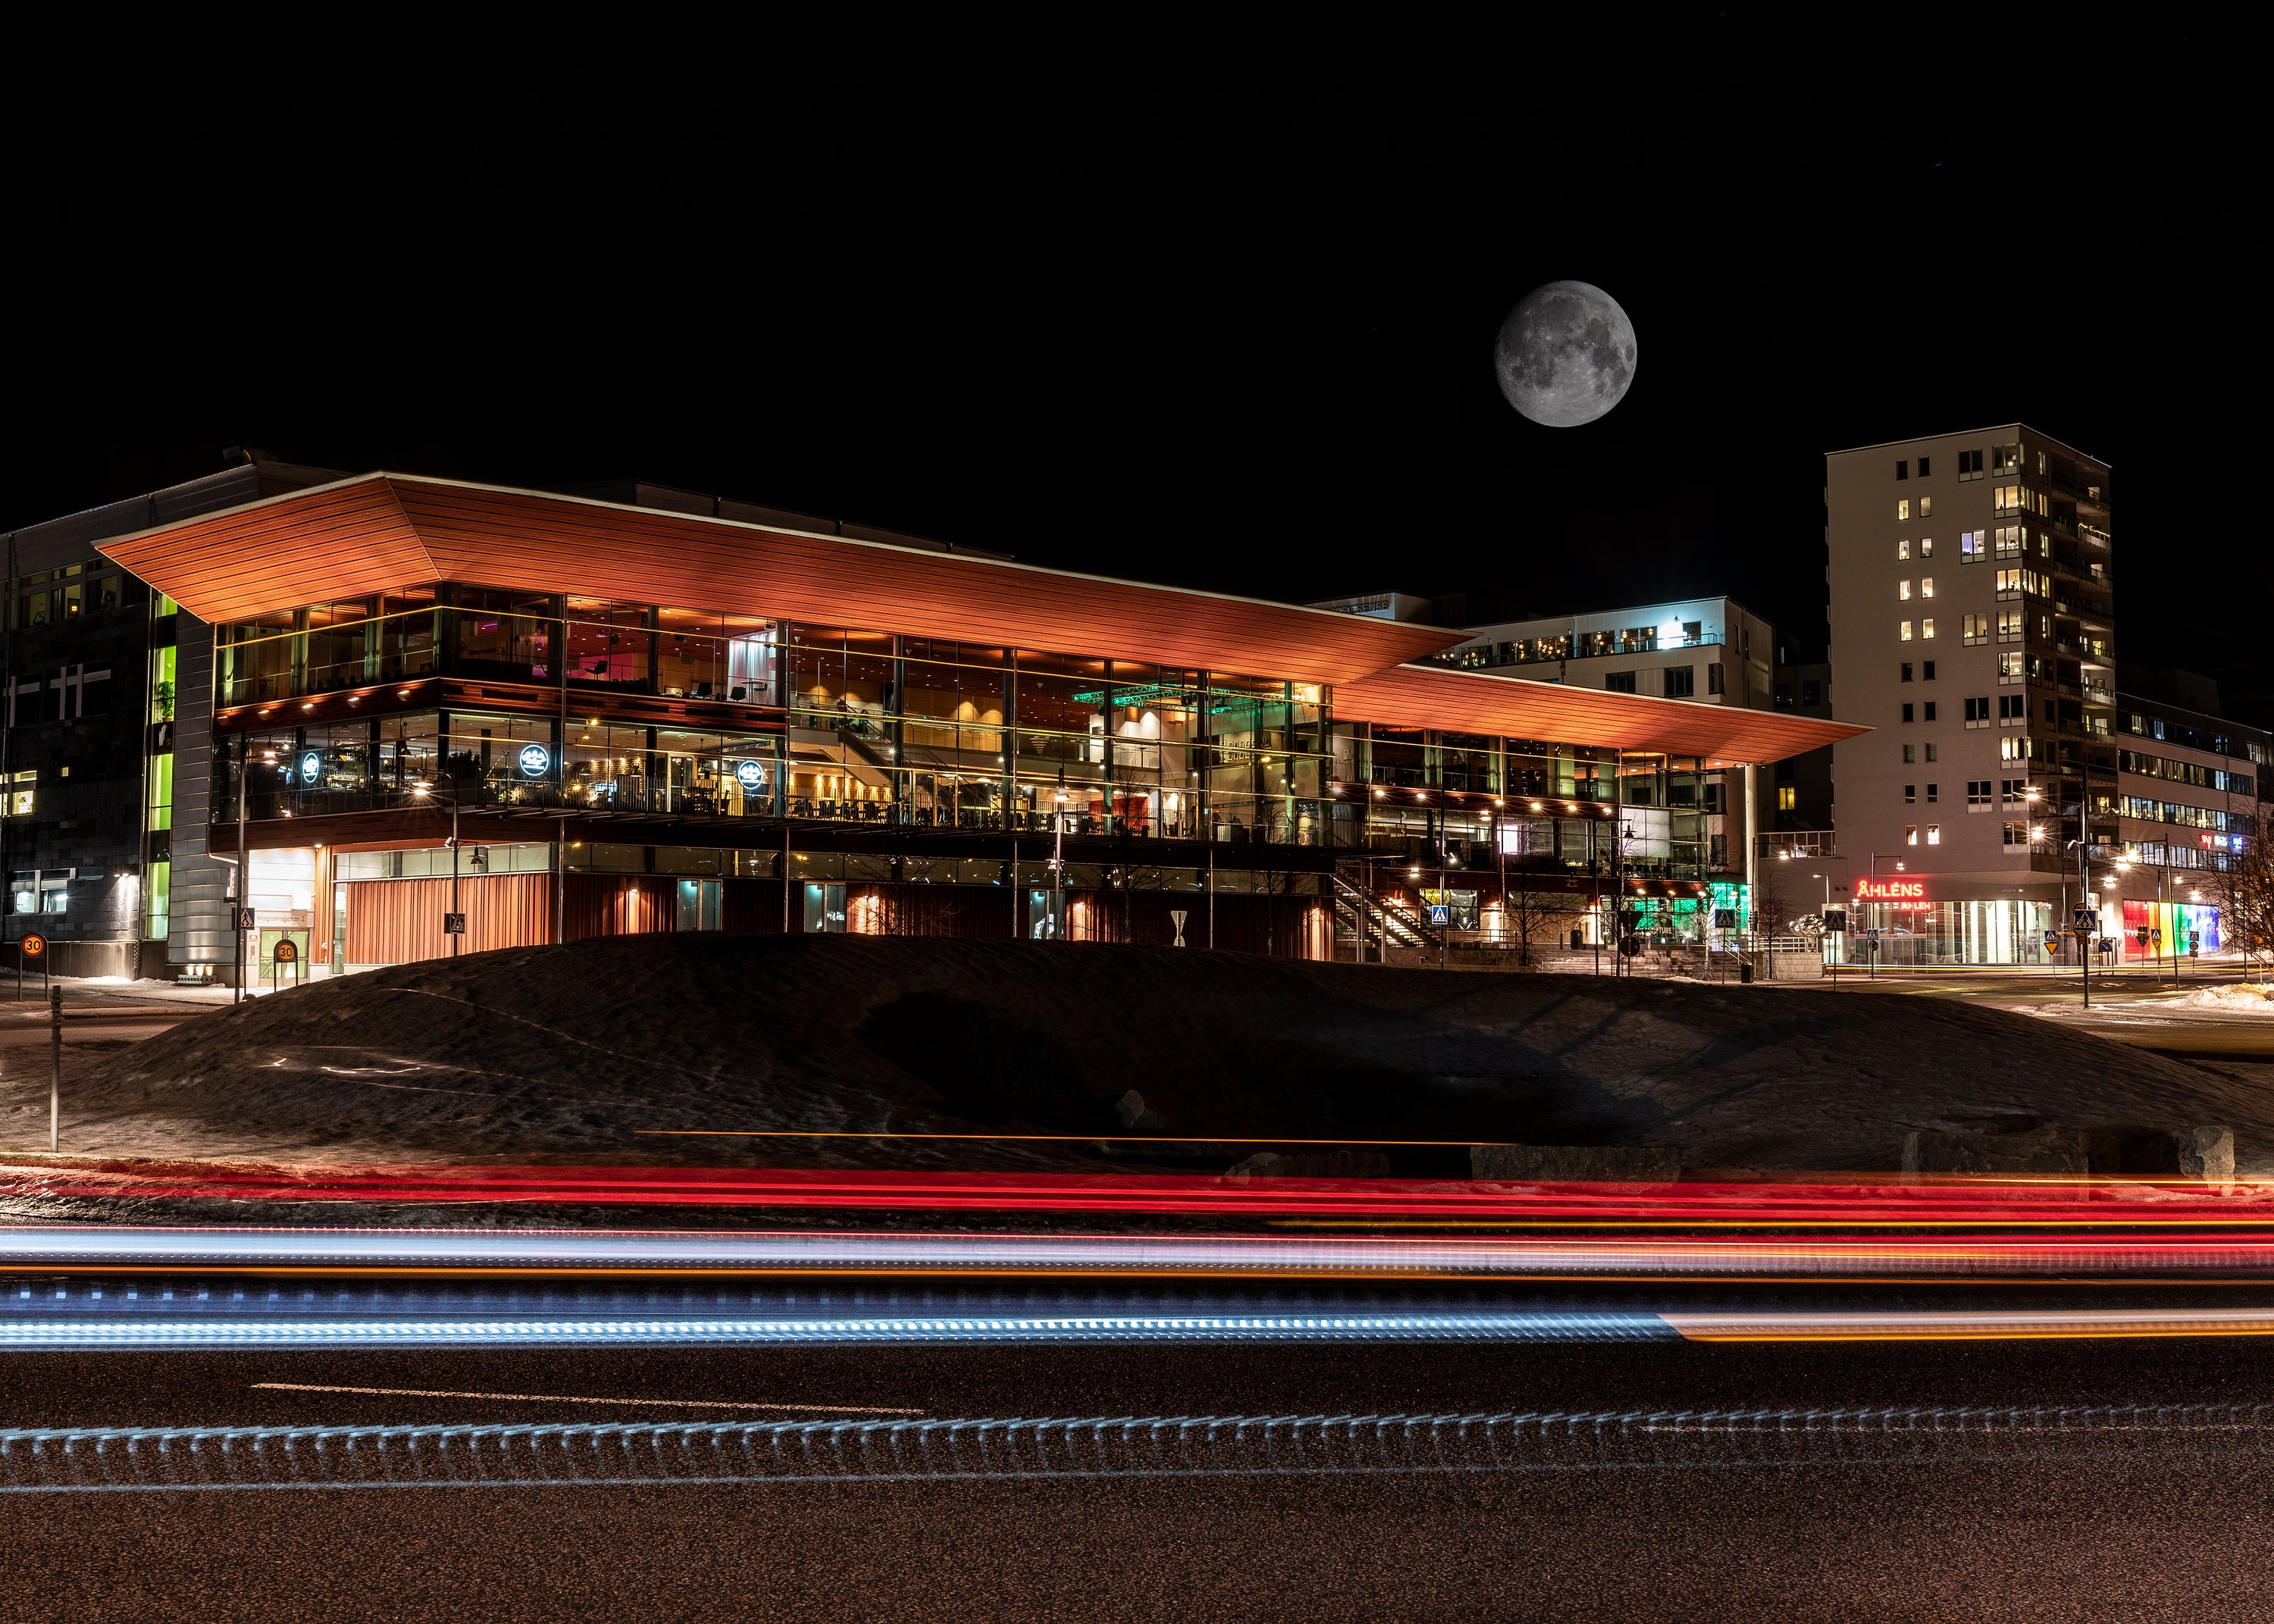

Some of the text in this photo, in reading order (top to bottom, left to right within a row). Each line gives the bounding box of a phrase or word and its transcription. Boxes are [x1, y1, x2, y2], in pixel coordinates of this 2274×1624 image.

[1356, 601, 1389, 613] SENSE
[1857, 880, 1923, 897] ÅHLÉNS
[27, 940, 41, 950] 30
[280, 947, 293, 958] 30
